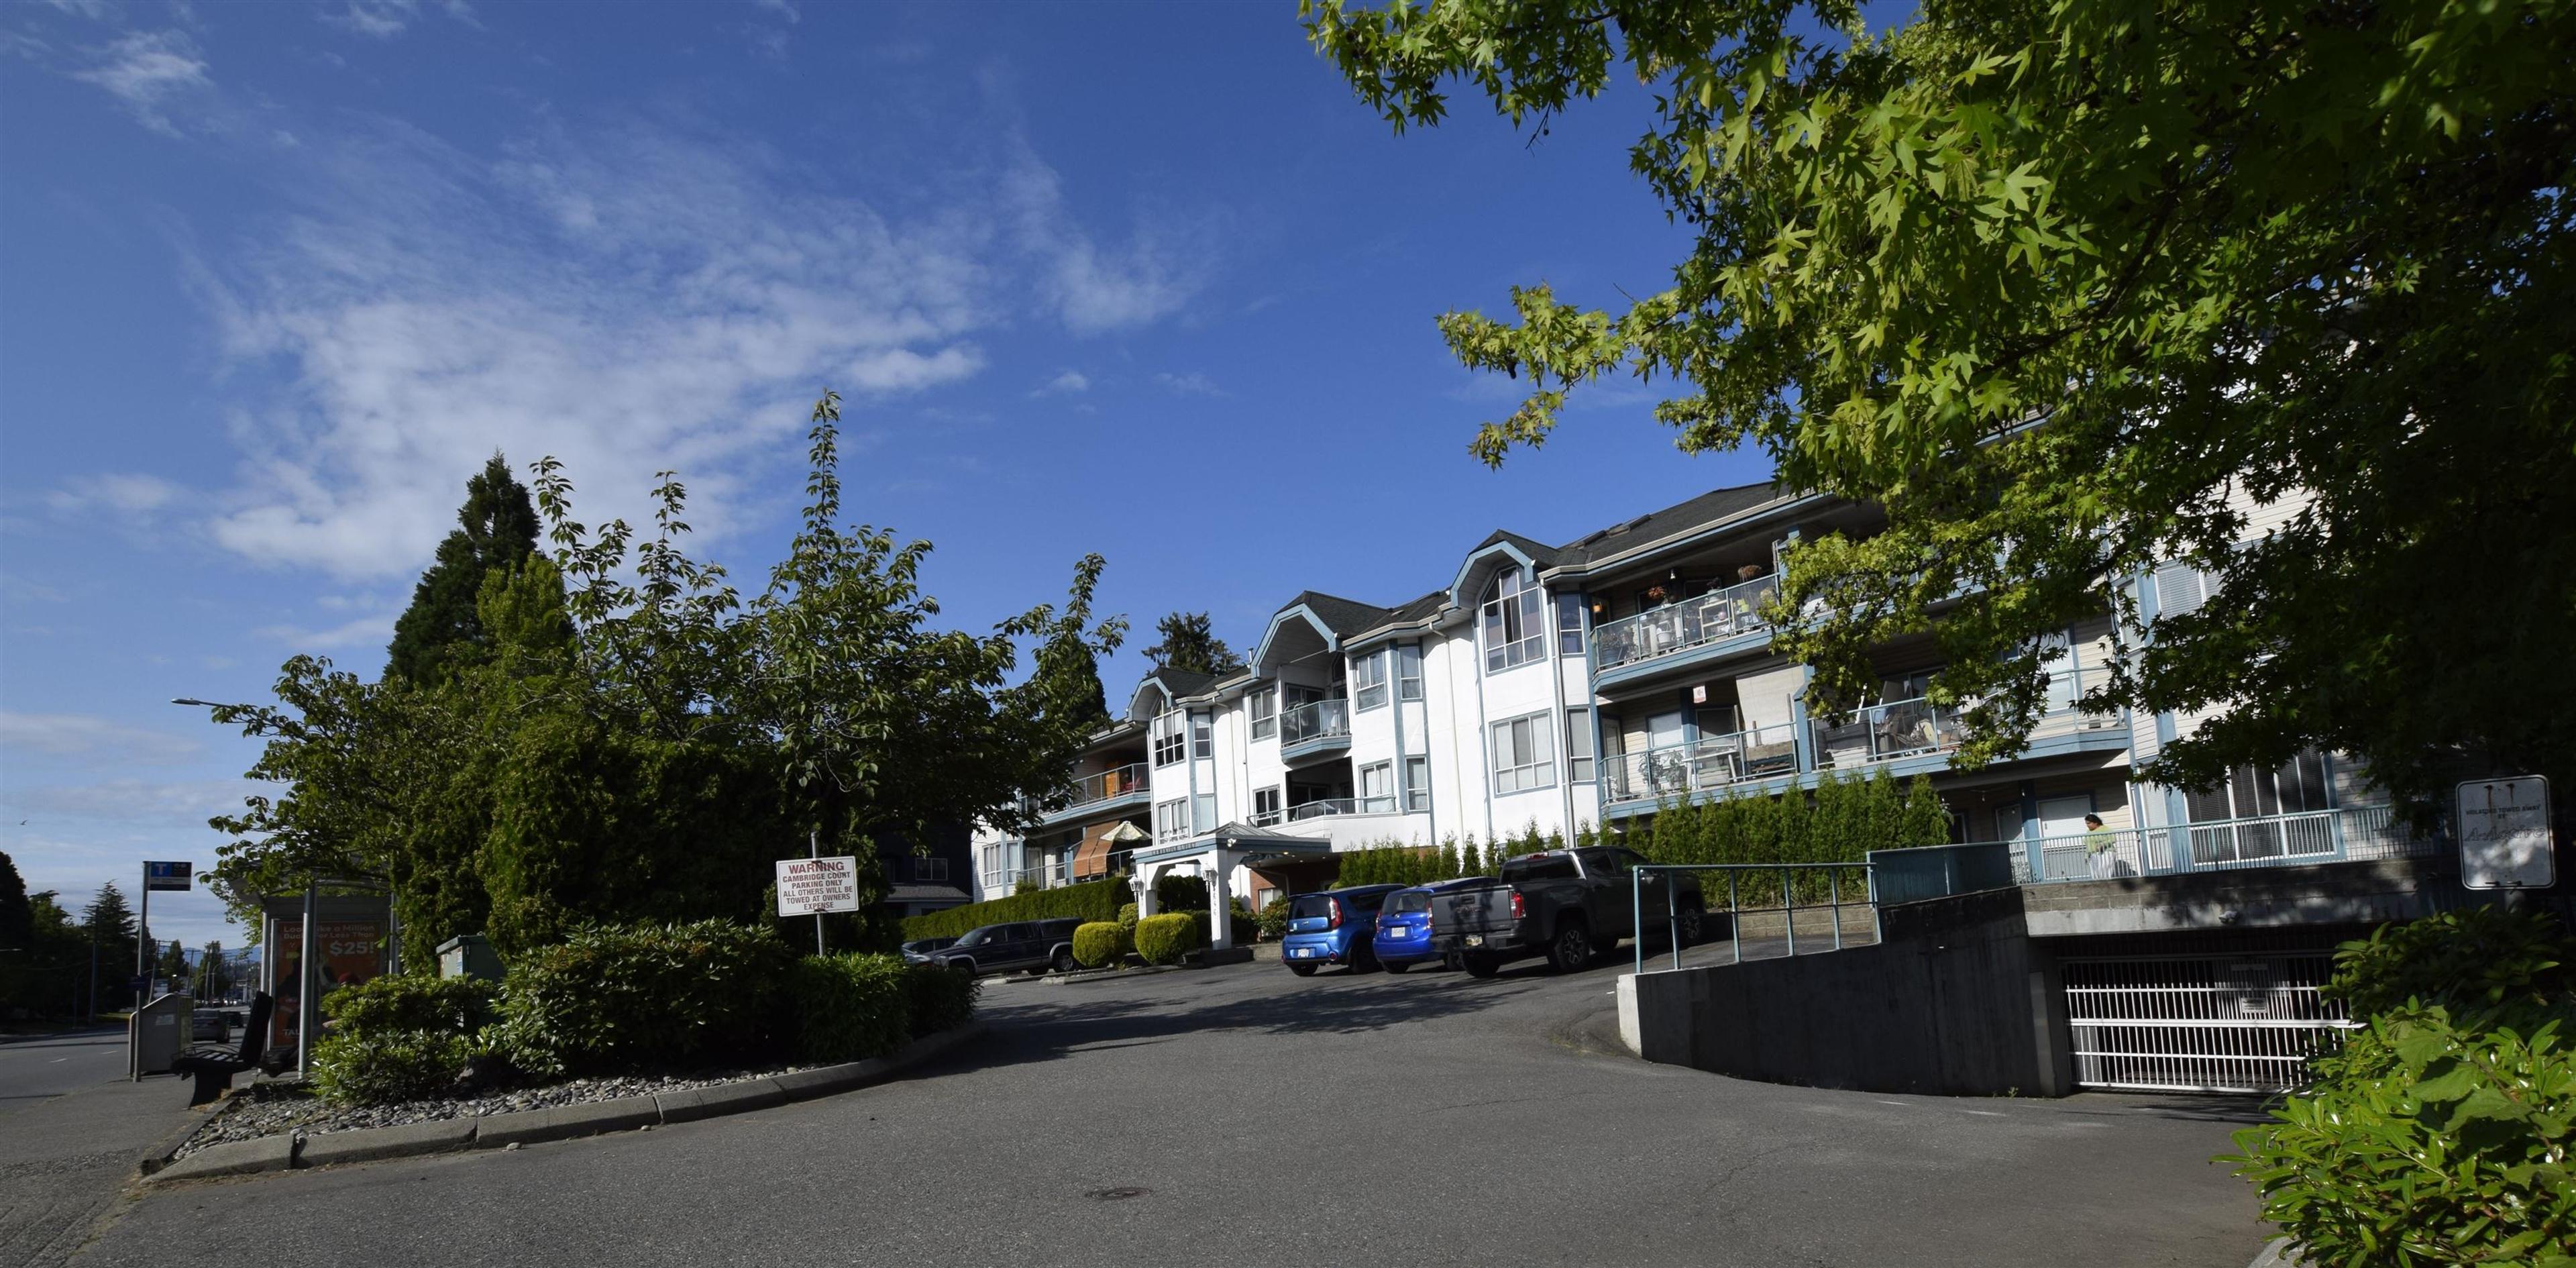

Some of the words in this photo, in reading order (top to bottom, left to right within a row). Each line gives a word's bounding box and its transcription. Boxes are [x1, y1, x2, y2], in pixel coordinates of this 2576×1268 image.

[788, 861, 845, 874] WARNING
[783, 873, 826, 883] CAMBRIDGE
[827, 871, 851, 880] COURT
[792, 880, 823, 890] PARKING
[826, 879, 843, 887] ONLY
[798, 888, 824, 896] OTHERS
[826, 886, 843, 894] WILL
[786, 896, 810, 904] TOWED
[822, 893, 851, 902] OWNERS
[804, 901, 834, 910] EXPENSE
[284, 925, 303, 933] Loo
[329, 940, 374, 957] $25!
